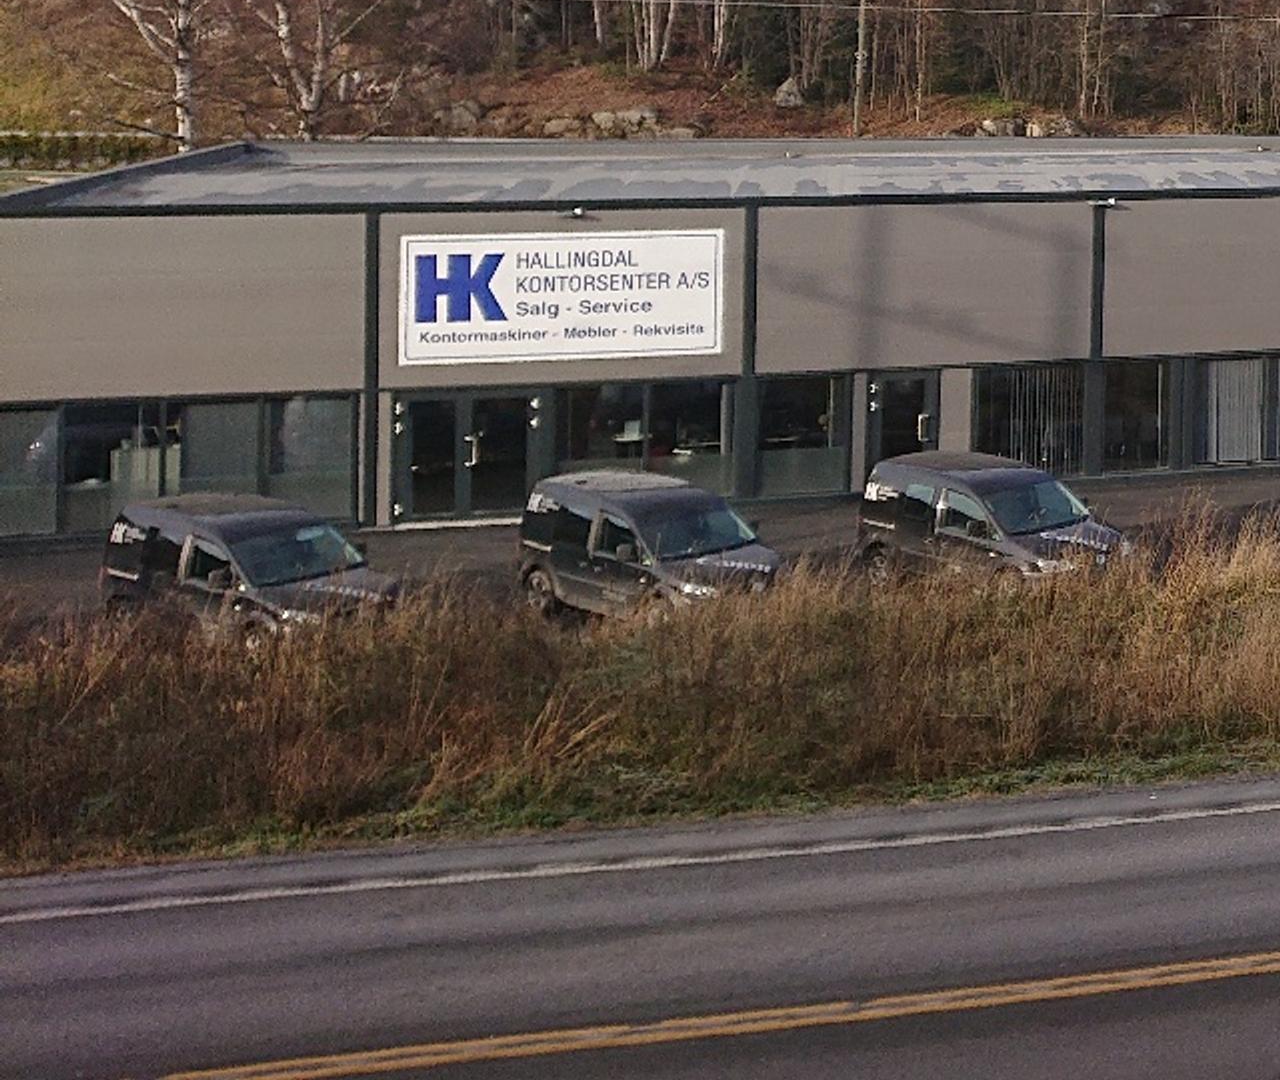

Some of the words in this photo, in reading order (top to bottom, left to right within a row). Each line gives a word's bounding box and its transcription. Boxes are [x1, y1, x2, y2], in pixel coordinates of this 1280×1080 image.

[516, 251, 638, 269] HALLINGDAL
[415, 252, 508, 323] HK
[516, 274, 670, 293] KONTORSENTER
[677, 272, 710, 290] A/S
[516, 301, 559, 318] Salg
[579, 300, 653, 314] Service
[419, 329, 547, 343] Kontormaskiner
[633, 324, 704, 337] Rekvisita
